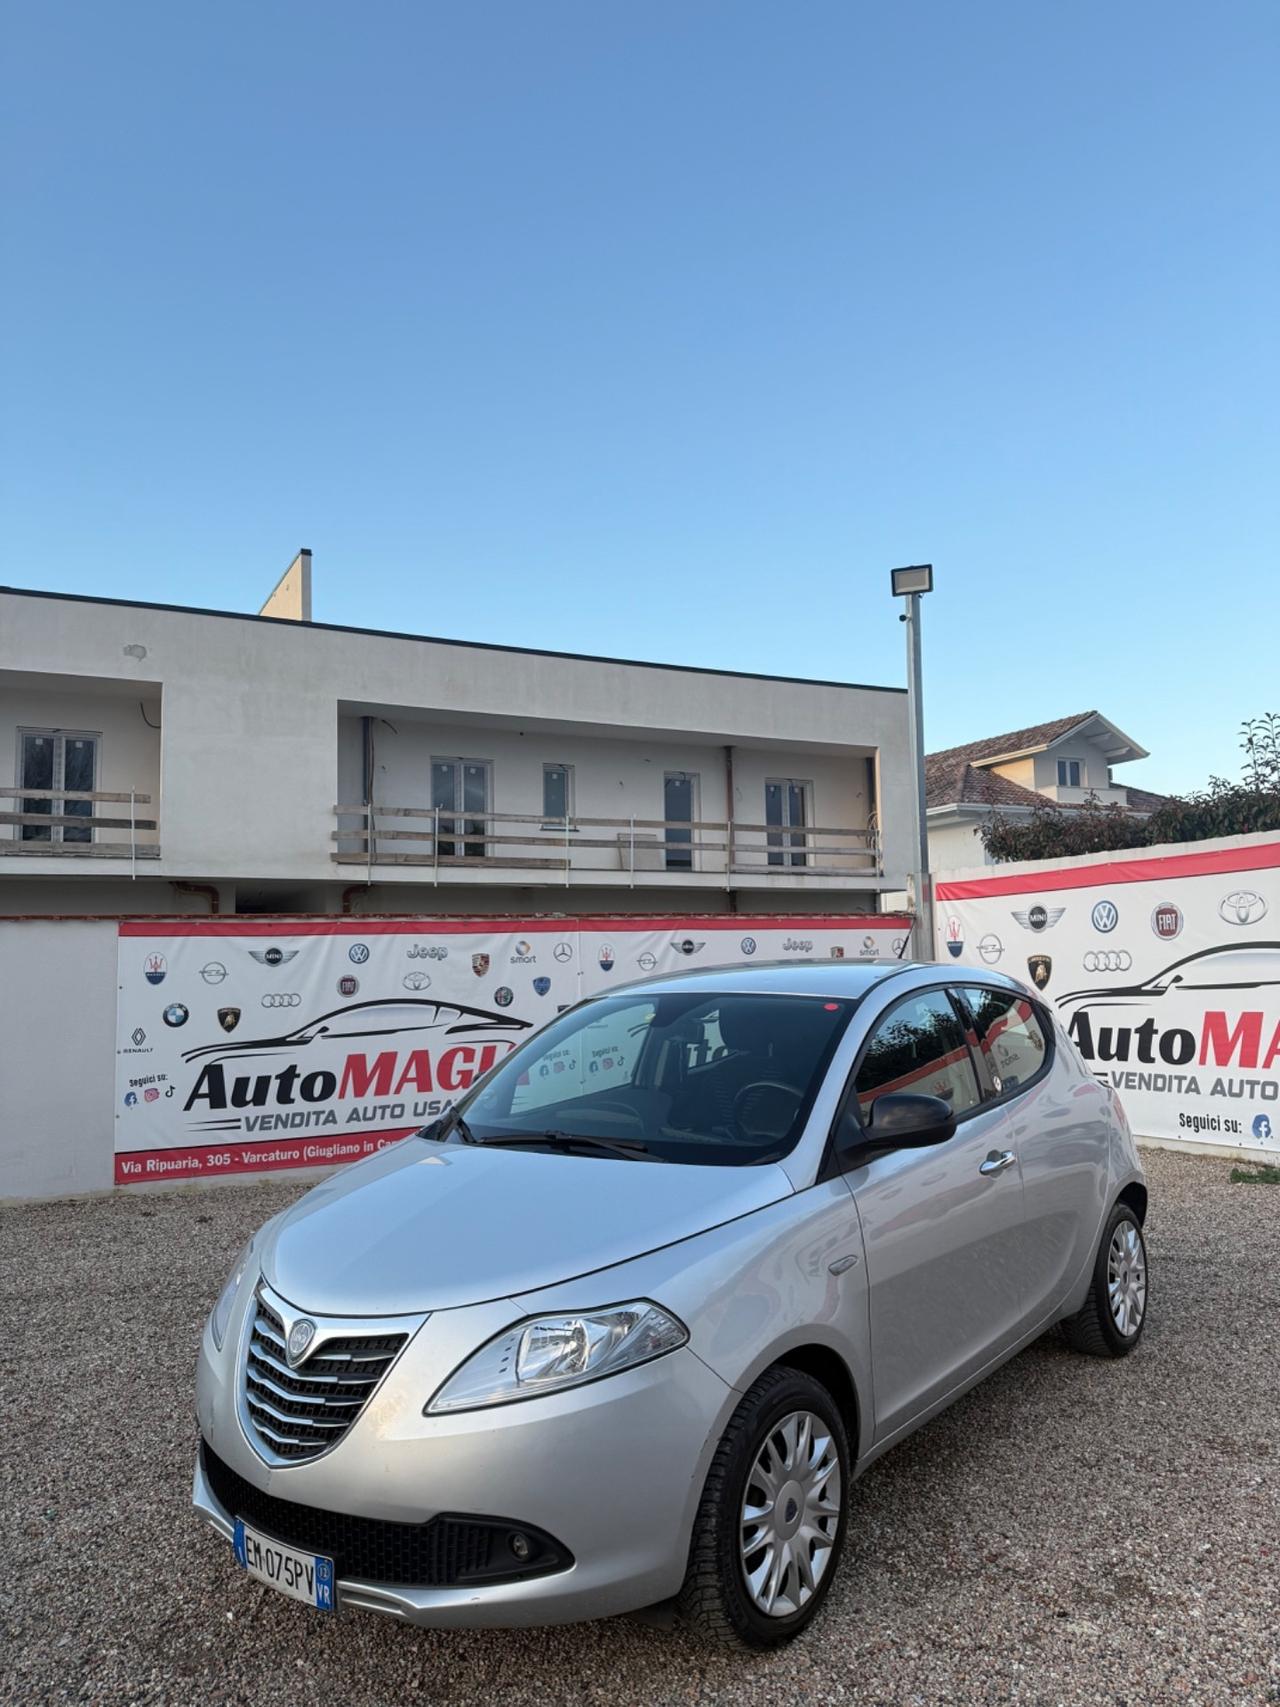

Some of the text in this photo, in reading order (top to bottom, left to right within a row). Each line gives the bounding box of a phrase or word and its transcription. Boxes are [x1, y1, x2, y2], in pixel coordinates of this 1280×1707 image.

[1158, 913, 1177, 931] FIAT
[407, 944, 448, 961] Jeep
[782, 938, 813, 952] Jeep
[859, 948, 880, 956] smart
[510, 955, 537, 964] smart
[129, 1073, 156, 1088] Seguici
[1111, 1070, 1279, 1101] VENDITA AUTO
[244, 1109, 338, 1132] VENDITA
[345, 1103, 405, 1123] AUTO
[1179, 1112, 1242, 1134] Seguici su:
[121, 1161, 142, 1174] Via
[146, 1156, 203, 1174] Ripuaria,
[206, 1153, 231, 1167] 305
[242, 1148, 300, 1164] Varcaturo
[303, 1143, 360, 1160] (Giugliano
[363, 1141, 373, 1152] in
[317, 1583, 330, 1604] VR
